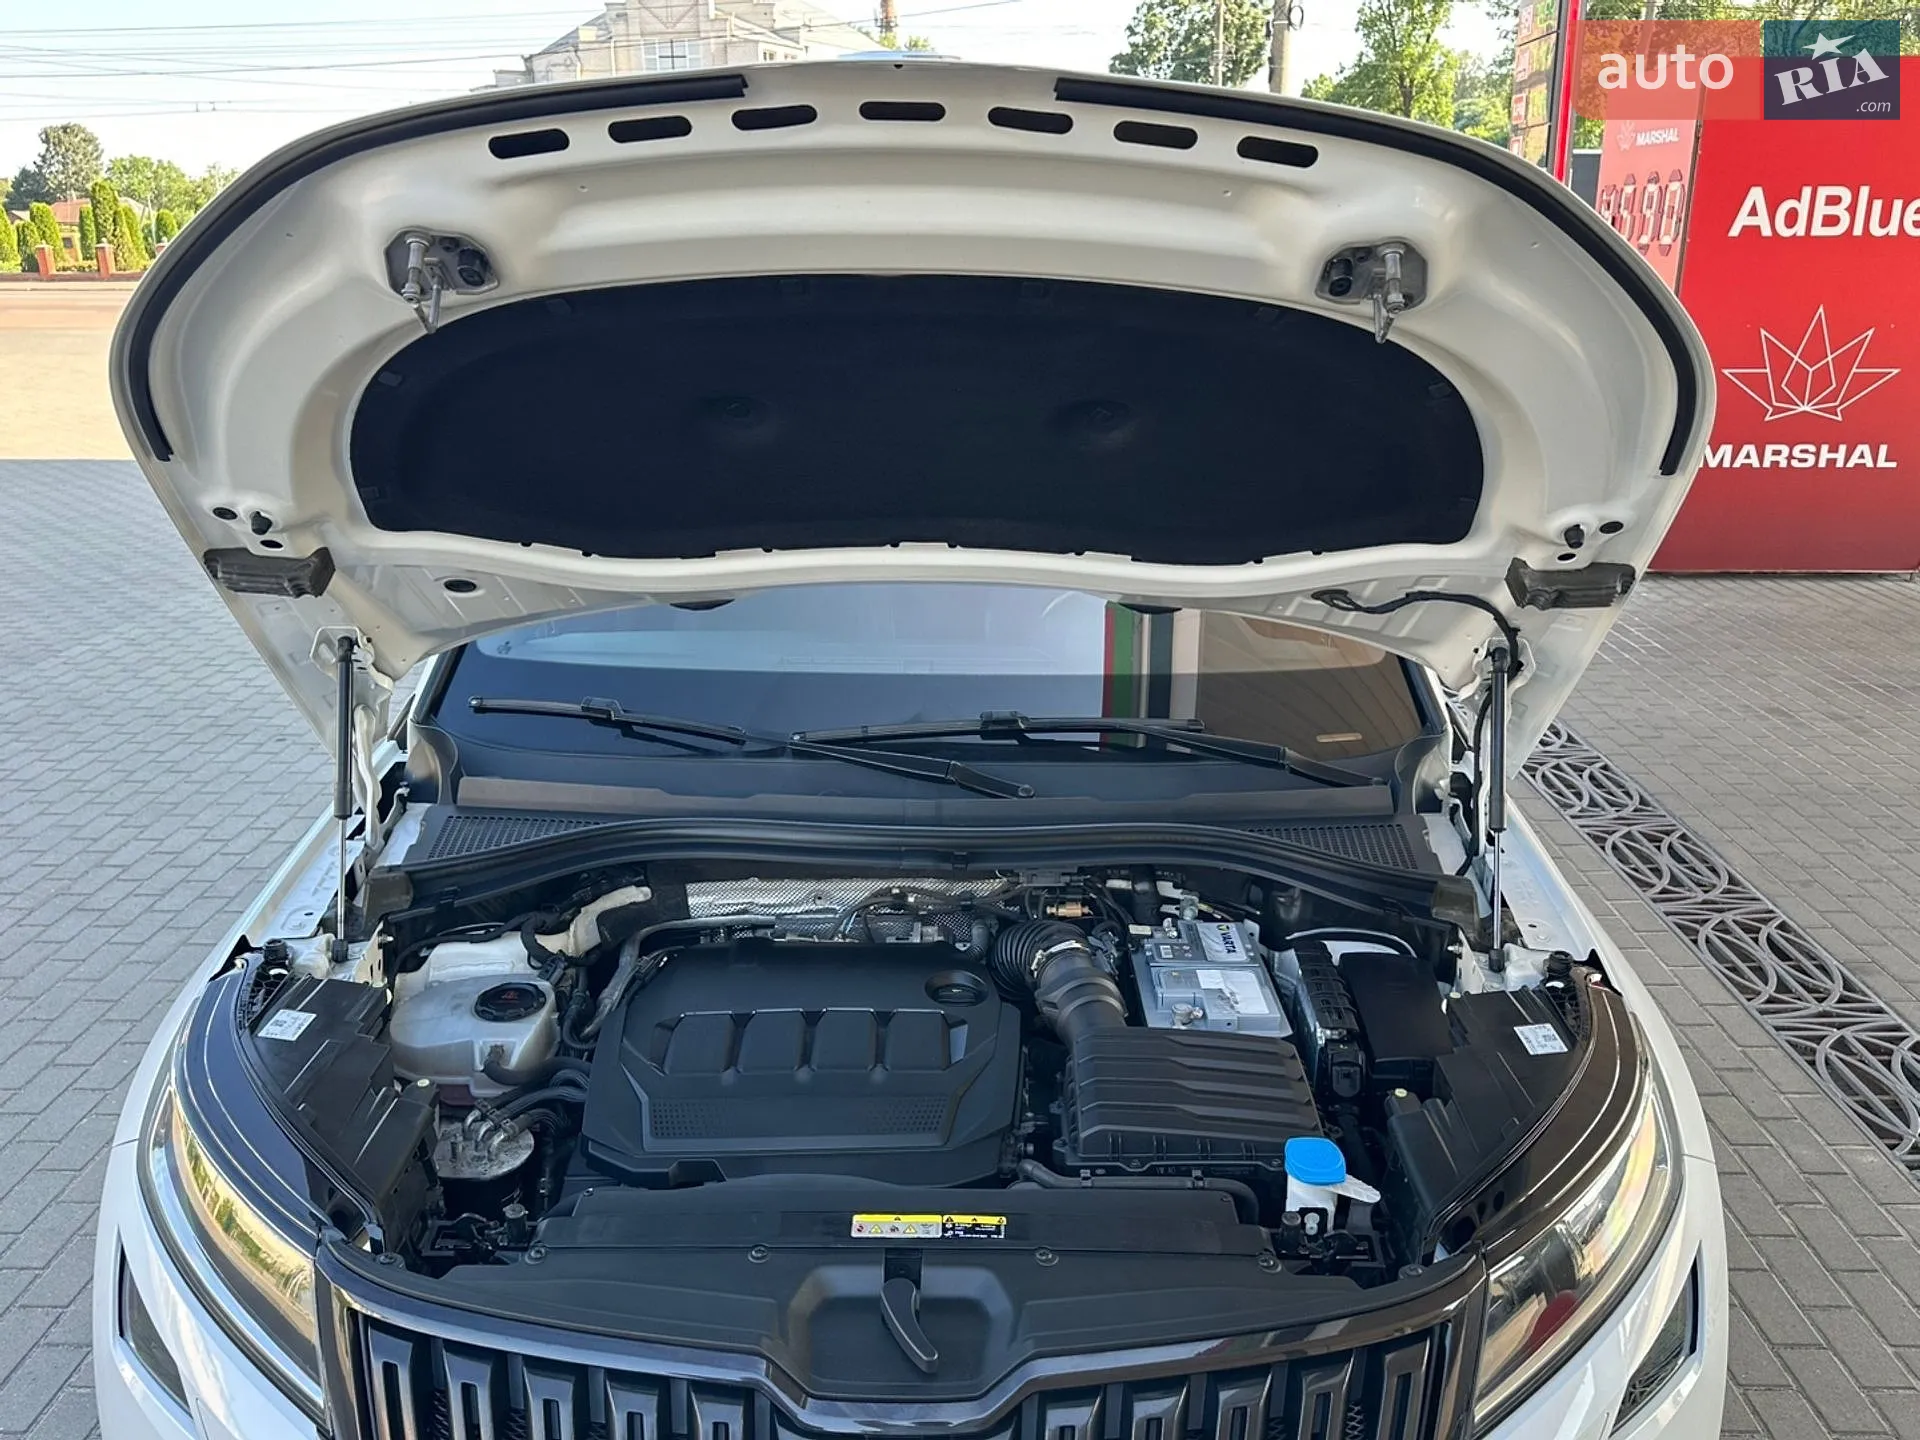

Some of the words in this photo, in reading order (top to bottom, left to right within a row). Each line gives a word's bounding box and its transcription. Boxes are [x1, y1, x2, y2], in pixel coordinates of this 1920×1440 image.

[1636, 128, 1680, 146] MARSHAL
[1728, 185, 1920, 238] AdBlue
[1699, 444, 1897, 468] MARSHAL
[1220, 932, 1237, 954] VARTA
